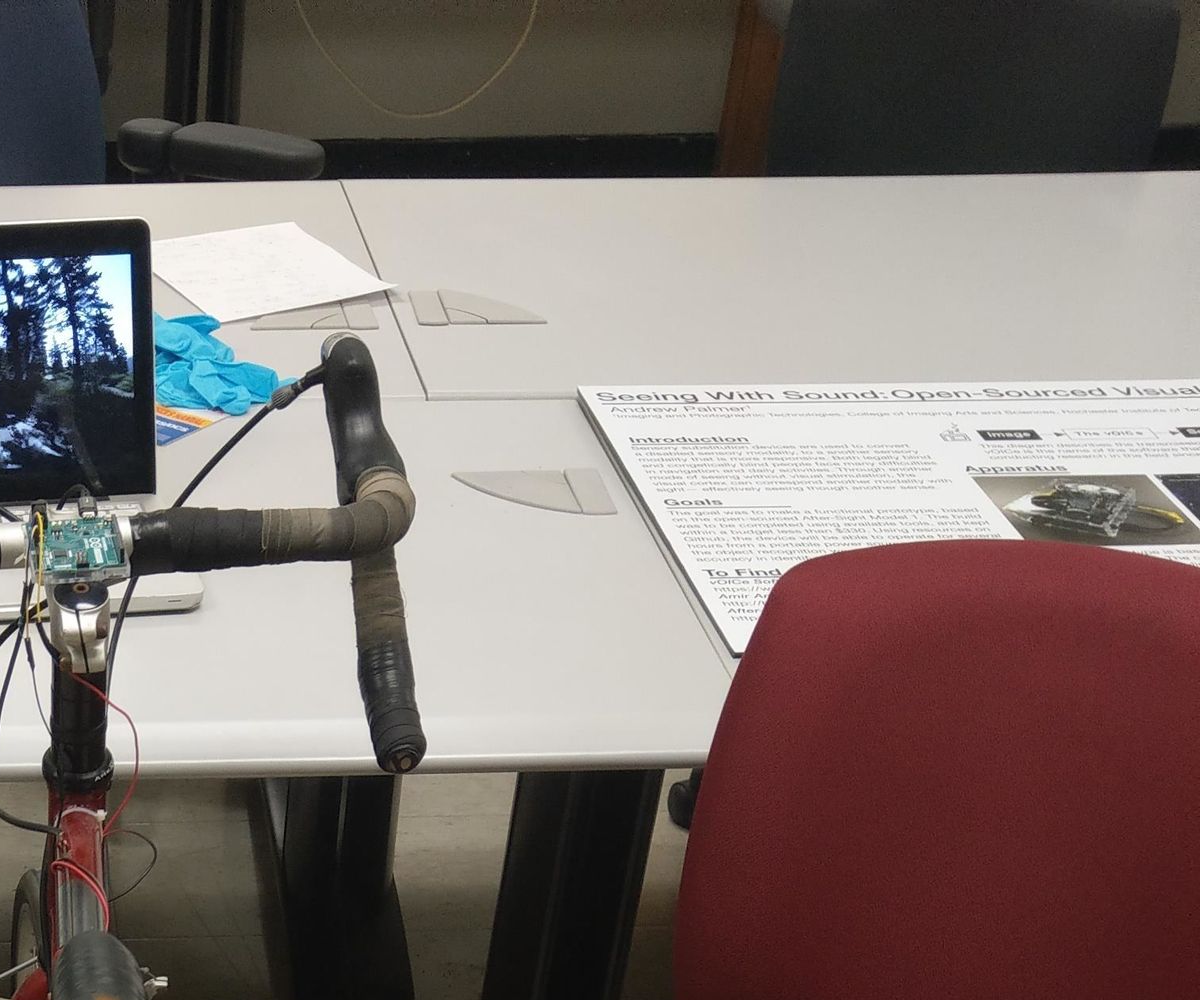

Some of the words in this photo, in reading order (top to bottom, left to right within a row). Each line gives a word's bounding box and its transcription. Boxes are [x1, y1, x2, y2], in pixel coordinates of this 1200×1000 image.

[597, 391, 700, 403] Seeing
[705, 390, 774, 400] With
[783, 389, 888, 399] Sound:
[891, 386, 1107, 400] Open-Sourced
[1112, 385, 1200, 395] Visual
[966, 464, 1068, 473] Apparatus
[664, 498, 723, 506] Goals
[735, 568, 782, 576] Find
[730, 614, 758, 622] http
